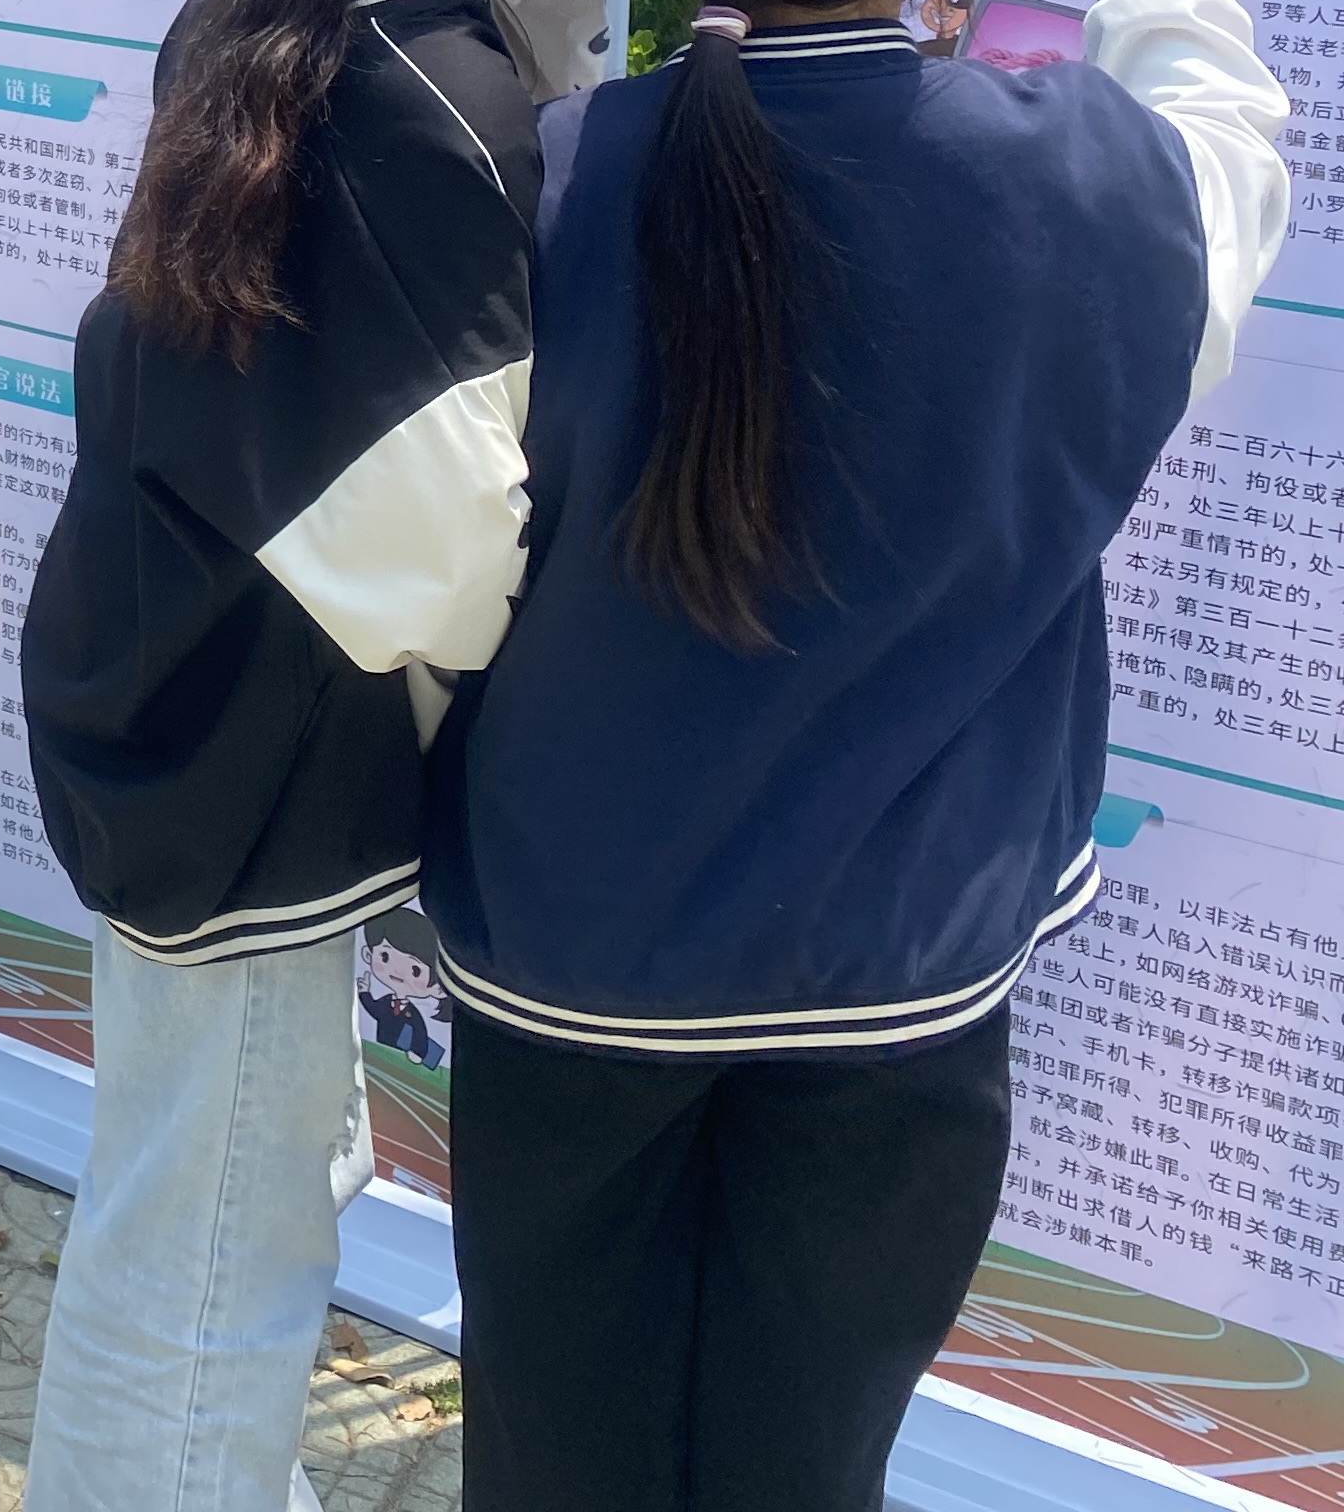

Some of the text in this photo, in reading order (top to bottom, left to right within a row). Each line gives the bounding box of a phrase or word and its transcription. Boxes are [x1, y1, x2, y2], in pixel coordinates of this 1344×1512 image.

[1269, 34, 1344, 58] 发送老
[1276, 128, 1344, 152] 骗金
[1099, 551, 1344, 611] 。本法另有规定的，
[1116, 517, 1344, 577] 别严重情节的，处
[1108, 648, 1344, 717] 掩饰、隐瞒的，处三
[1080, 907, 1344, 995] 被害人陷入错误认识而
[1101, 876, 1344, 960] 犯罪，以非法占有他
[1046, 933, 1344, 1025] 线上，如网络游戏诈骗、
[1011, 1013, 1344, 1128] 账户、手机卡，转移诈骗款项
[997, 1199, 1156, 1268] 就会涉嫌本罪。
